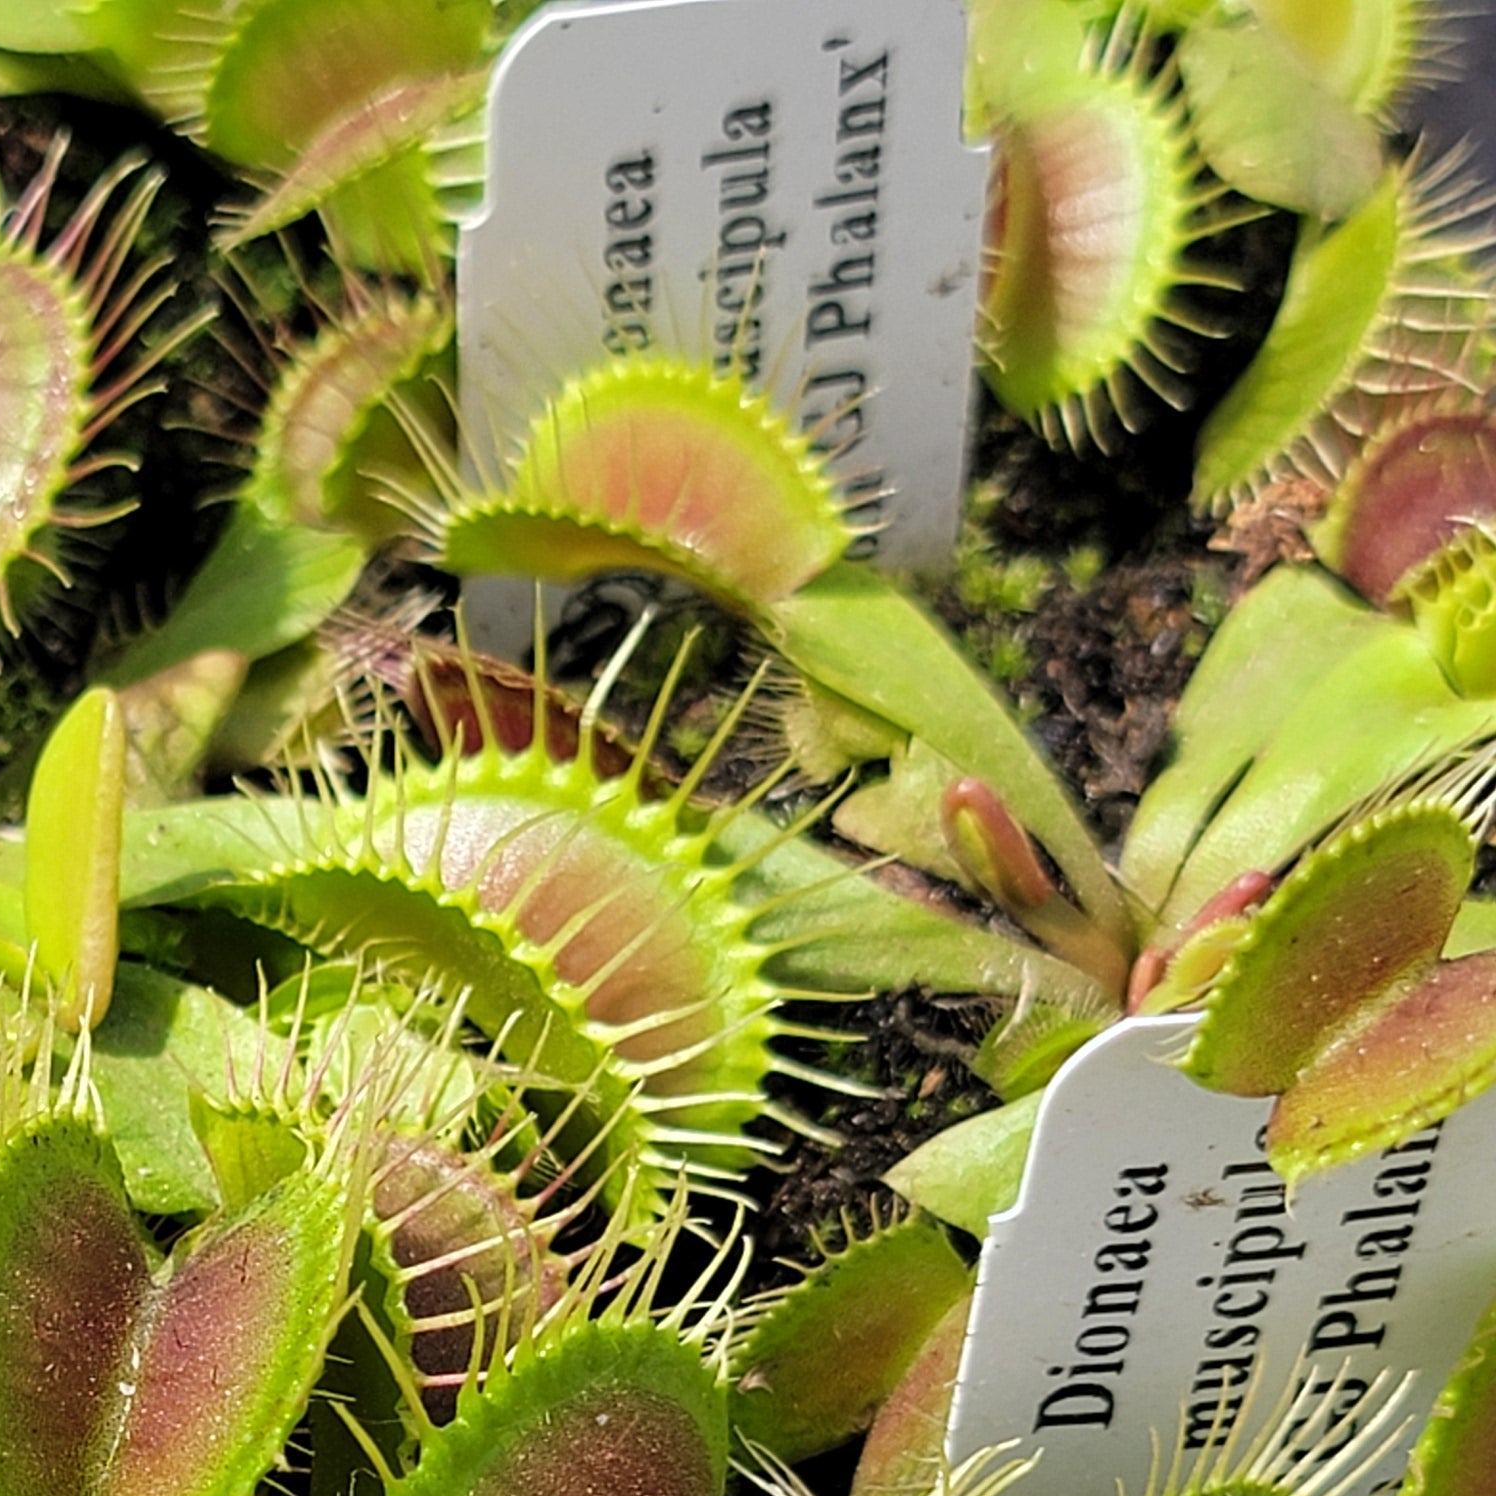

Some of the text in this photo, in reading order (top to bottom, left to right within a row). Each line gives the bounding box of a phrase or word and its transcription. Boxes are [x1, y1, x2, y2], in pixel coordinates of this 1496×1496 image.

[603, 148, 655, 356] onaea
[700, 98, 787, 382] uscipula
[808, 36, 891, 349] Phalanx'
[1032, 1162, 1169, 1436] Dionaea
